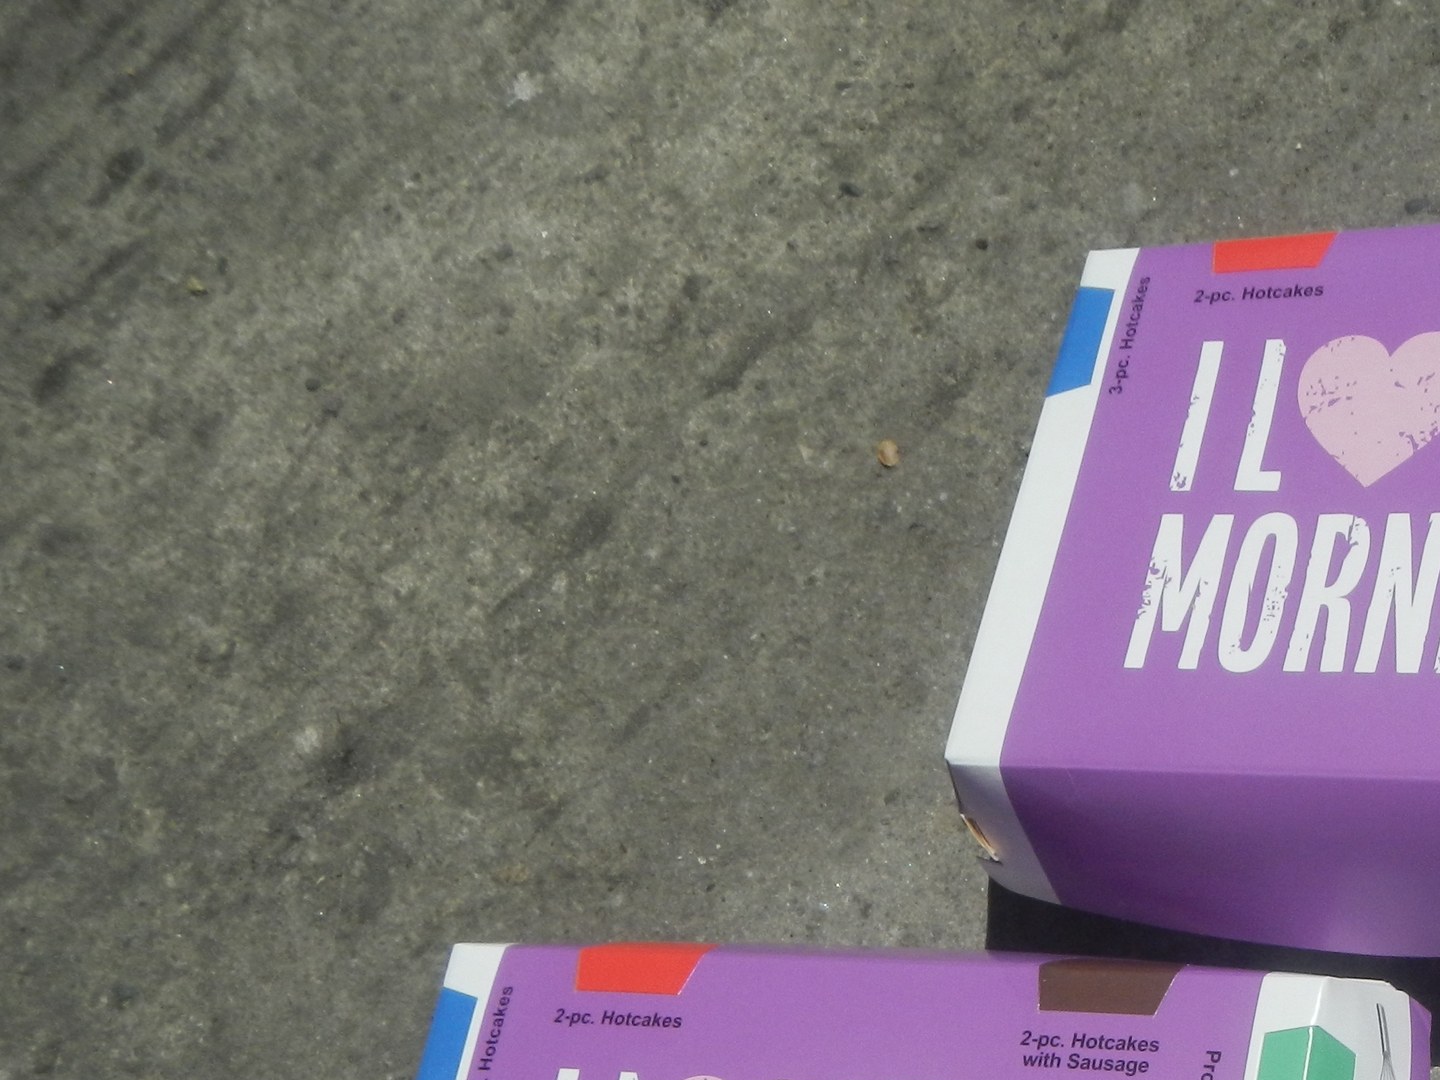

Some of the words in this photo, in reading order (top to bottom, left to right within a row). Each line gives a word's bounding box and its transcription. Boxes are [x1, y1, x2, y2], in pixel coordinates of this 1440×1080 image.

[1194, 288, 1236, 305] 2-pc.
[1241, 283, 1324, 301] Hotcakes
[1108, 355, 1130, 395] 3-pc.
[1119, 276, 1151, 350] Hotcakes
[1169, 341, 1224, 492] I
[479, 986, 514, 1072] Hotcakes
[554, 1008, 595, 1028] 2-pc.
[601, 1010, 683, 1029] Hotcakes
[1020, 1030, 1065, 1049] 2-pc.
[1071, 1032, 1160, 1053] Hotcakes
[1023, 1051, 1062, 1070] with
[1067, 1053, 1150, 1077] Sausage
